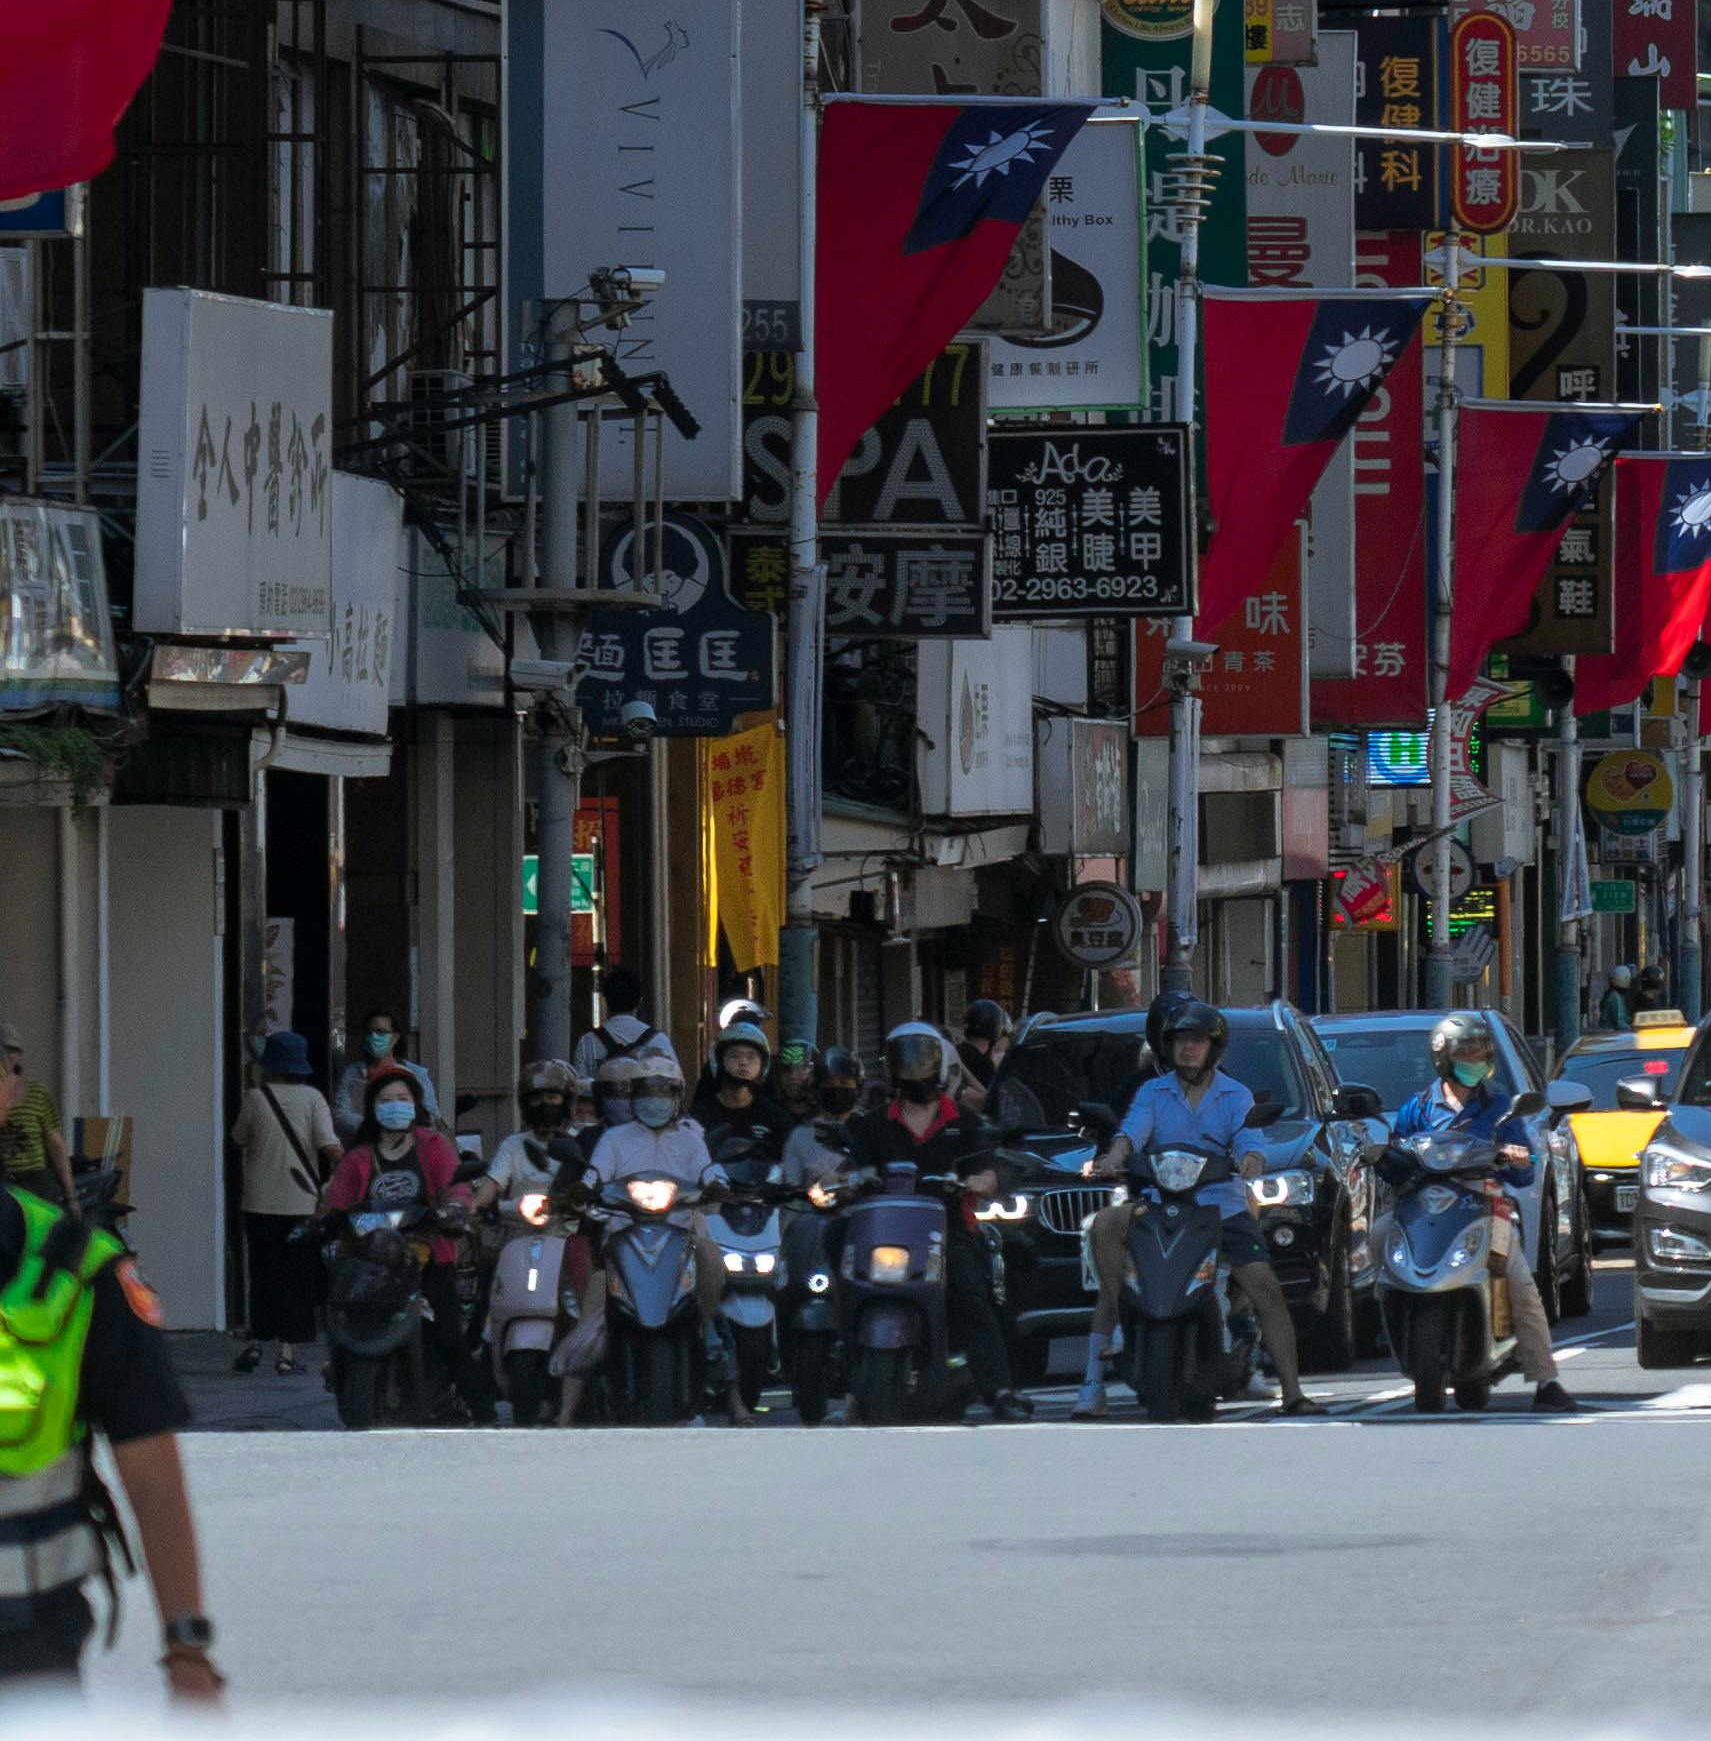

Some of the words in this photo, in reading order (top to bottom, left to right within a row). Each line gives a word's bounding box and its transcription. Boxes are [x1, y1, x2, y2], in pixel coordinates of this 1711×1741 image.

[1380, 57, 1422, 191] 復健科
[1279, 166, 1340, 187] Marie
[1085, 212, 1113, 227] Box
[745, 417, 964, 522] SPA
[1035, 490, 1067, 505] 925
[1558, 367, 1598, 617] 呼氣鞋
[1035, 507, 1068, 574] 純銀
[1082, 487, 1116, 572] 美睫
[1129, 487, 1162, 570] 美甲
